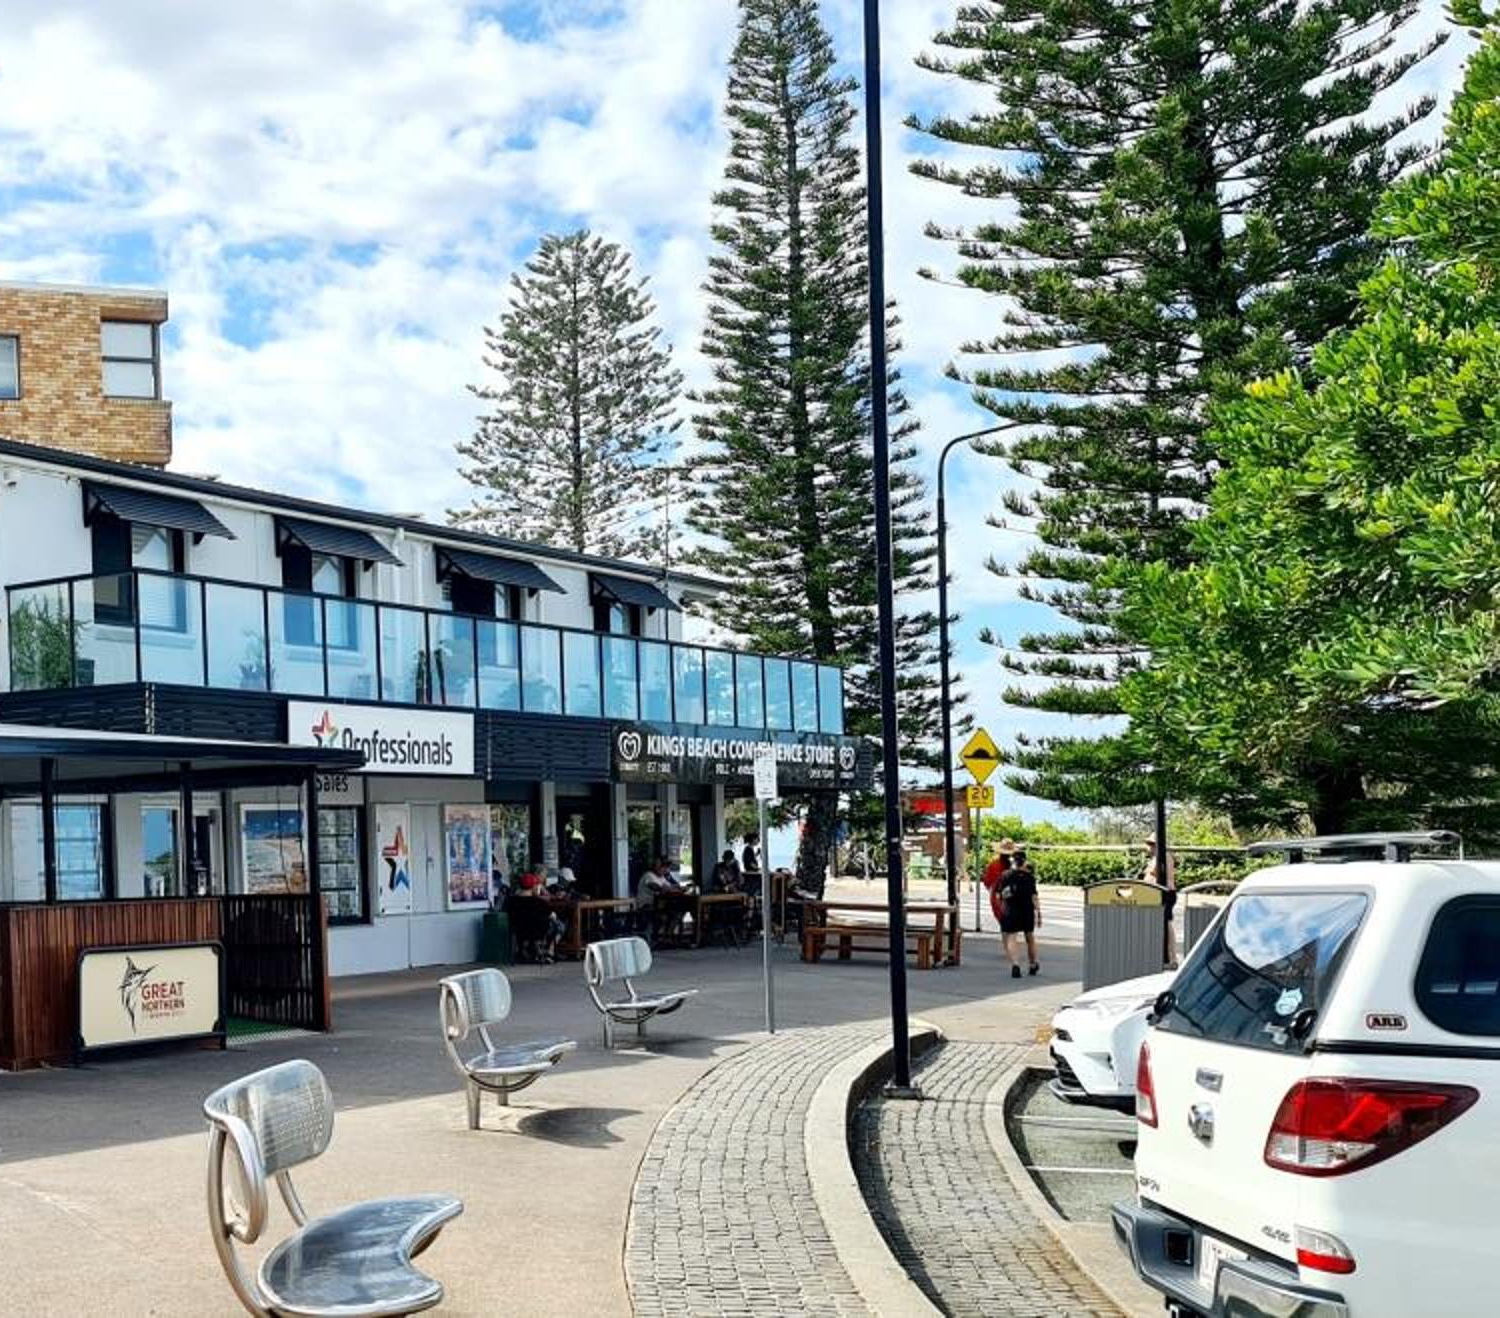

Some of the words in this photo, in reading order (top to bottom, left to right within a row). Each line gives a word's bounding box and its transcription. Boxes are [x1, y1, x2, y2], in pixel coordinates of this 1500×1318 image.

[647, 735, 685, 757] KINGS
[687, 737, 727, 759] BEACH
[805, 744, 835, 765] STORE
[972, 787, 989, 800] 20
[141, 980, 185, 1001] GREAT
[141, 998, 186, 1012] NORTHERN
